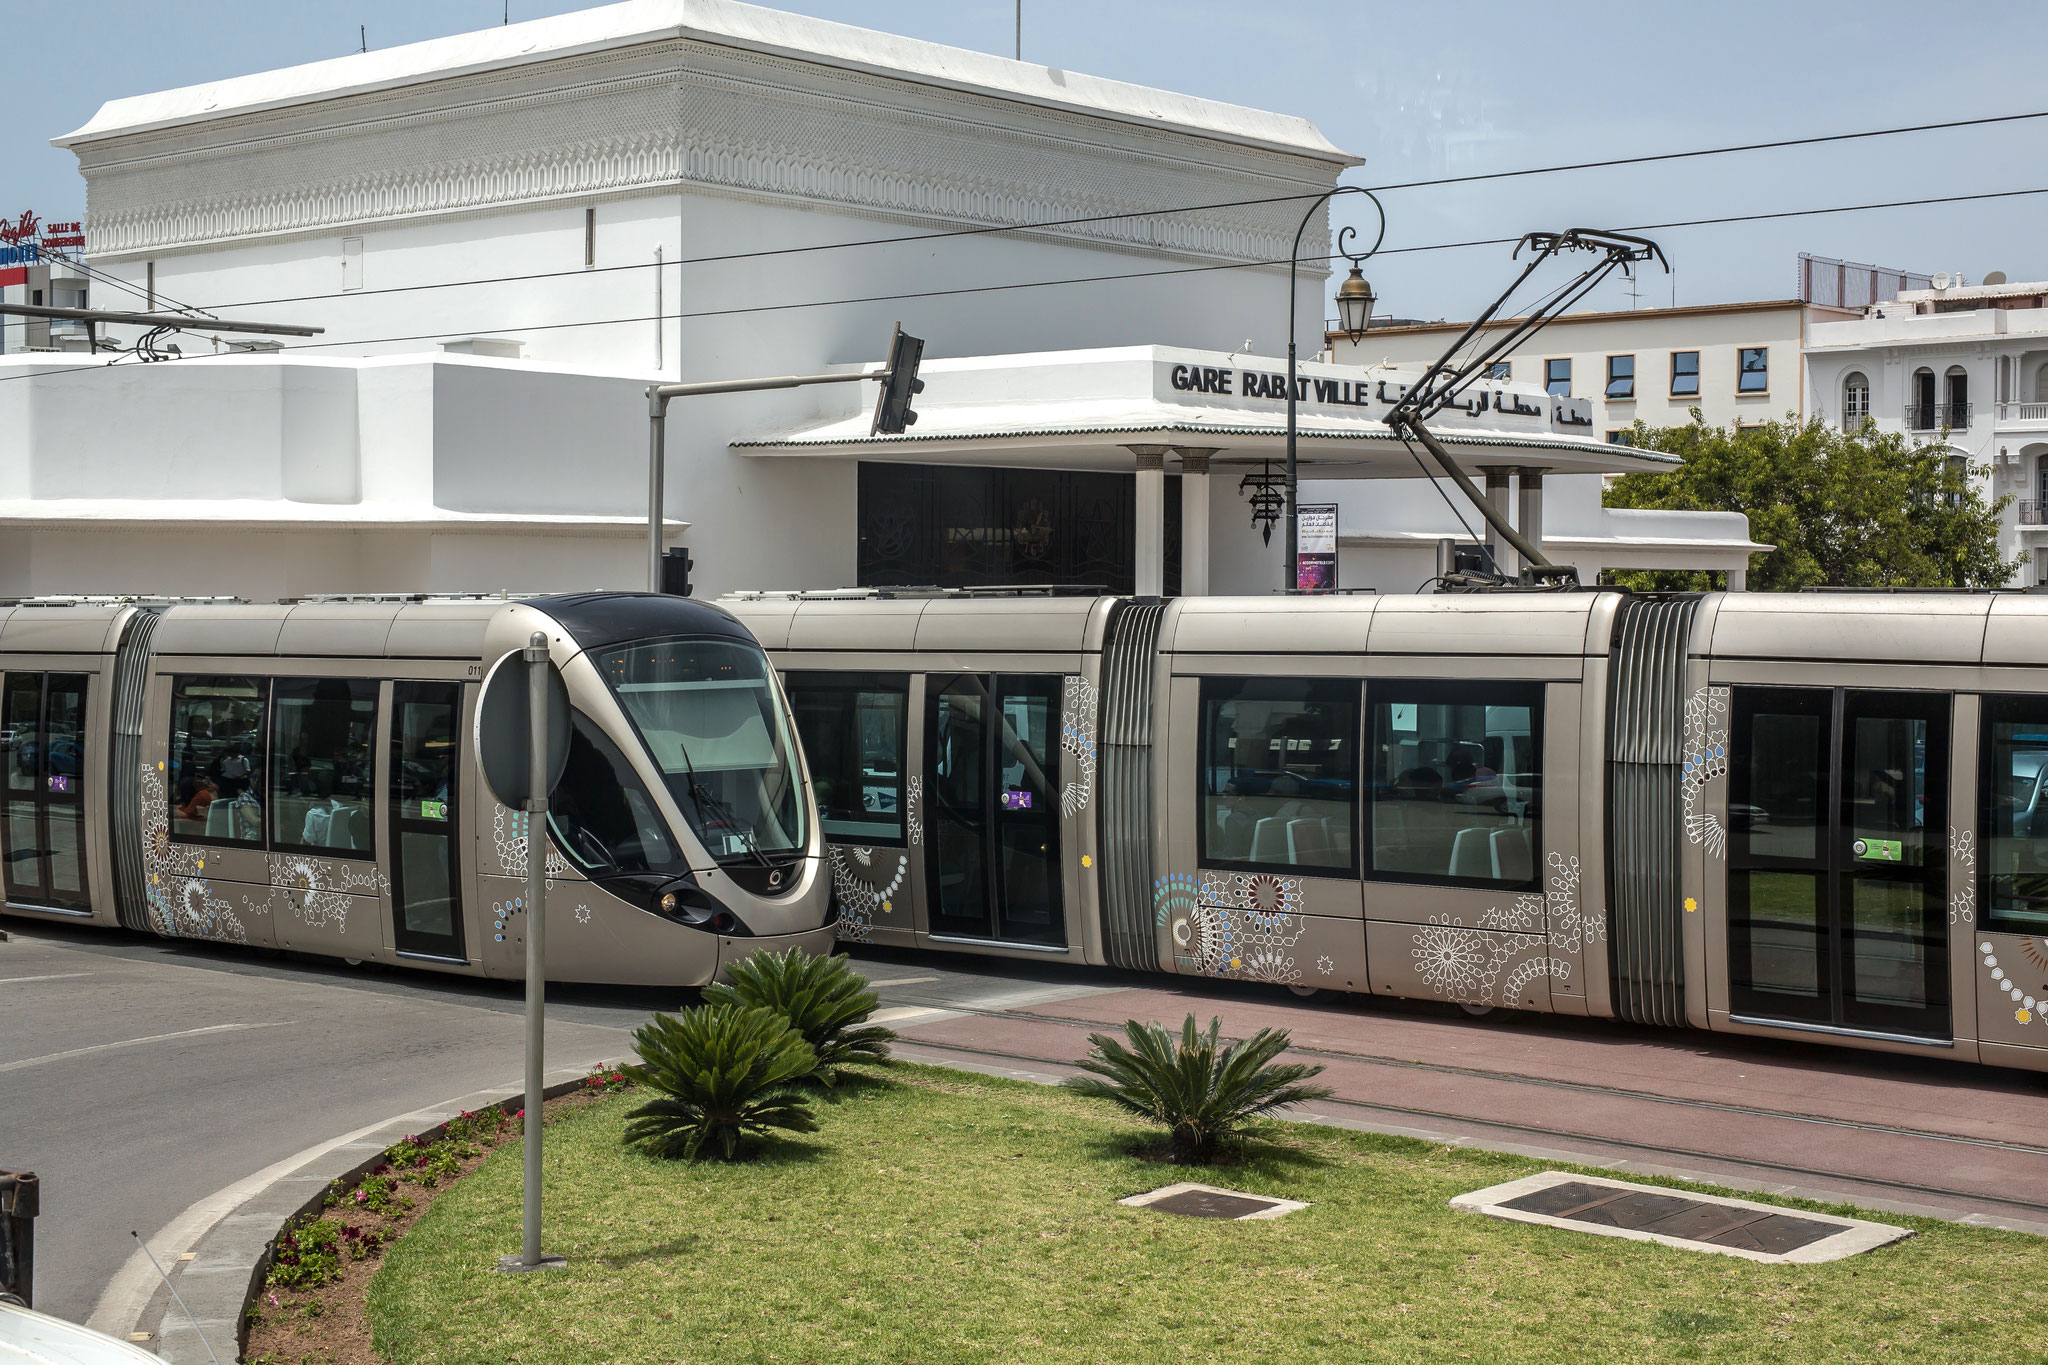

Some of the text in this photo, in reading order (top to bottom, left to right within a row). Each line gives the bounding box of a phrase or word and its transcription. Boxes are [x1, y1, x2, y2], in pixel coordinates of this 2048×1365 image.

[48, 222, 80, 233] SALLE DE
[1171, 365, 1232, 395] GARE
[1314, 379, 1369, 406] VILLE
[1493, 390, 1542, 417] محطة
[468, 666, 481, 675] 011
